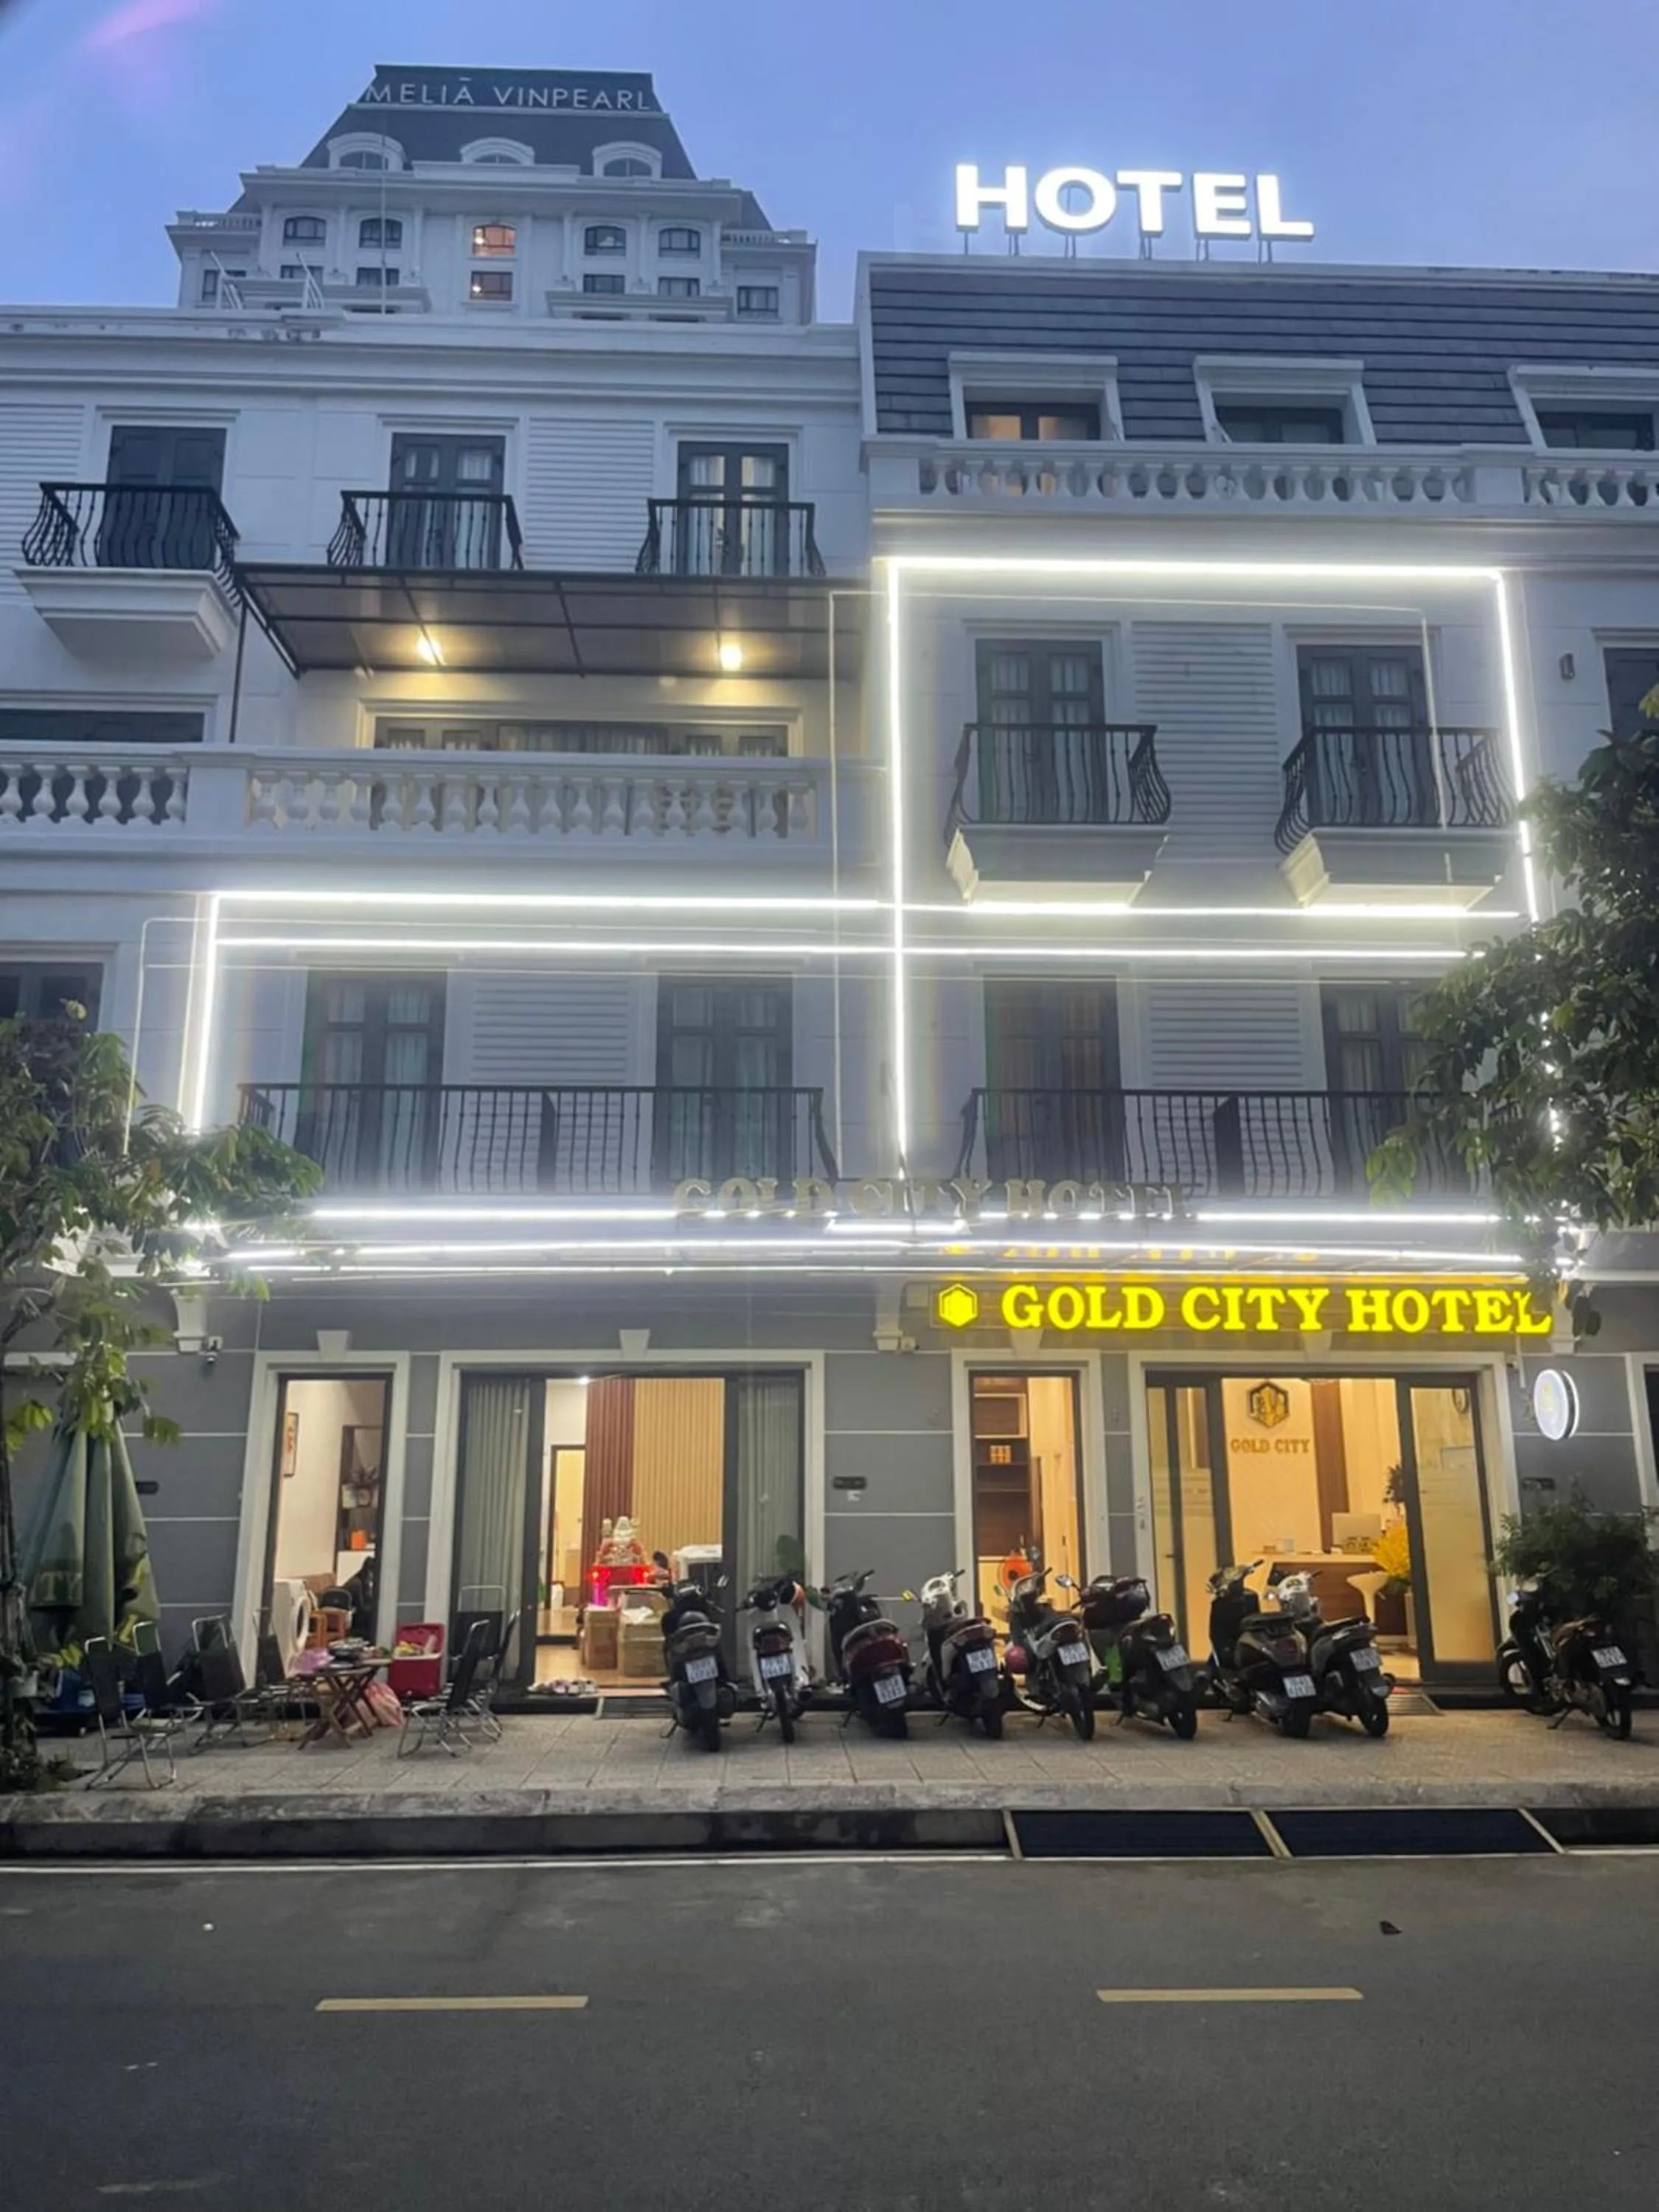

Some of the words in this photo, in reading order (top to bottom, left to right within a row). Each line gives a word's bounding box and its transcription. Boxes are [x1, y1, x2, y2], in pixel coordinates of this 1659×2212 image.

[493, 86, 650, 111] VINPEARL
[956, 164, 1315, 241] HOTEL
[1002, 1284, 1165, 1329] GOLD
[1181, 1287, 1329, 1330] CITY
[1346, 1289, 1553, 1334] HOTEL
[1231, 1439, 1270, 1453] GOLD
[1274, 1439, 1310, 1453] CITY
